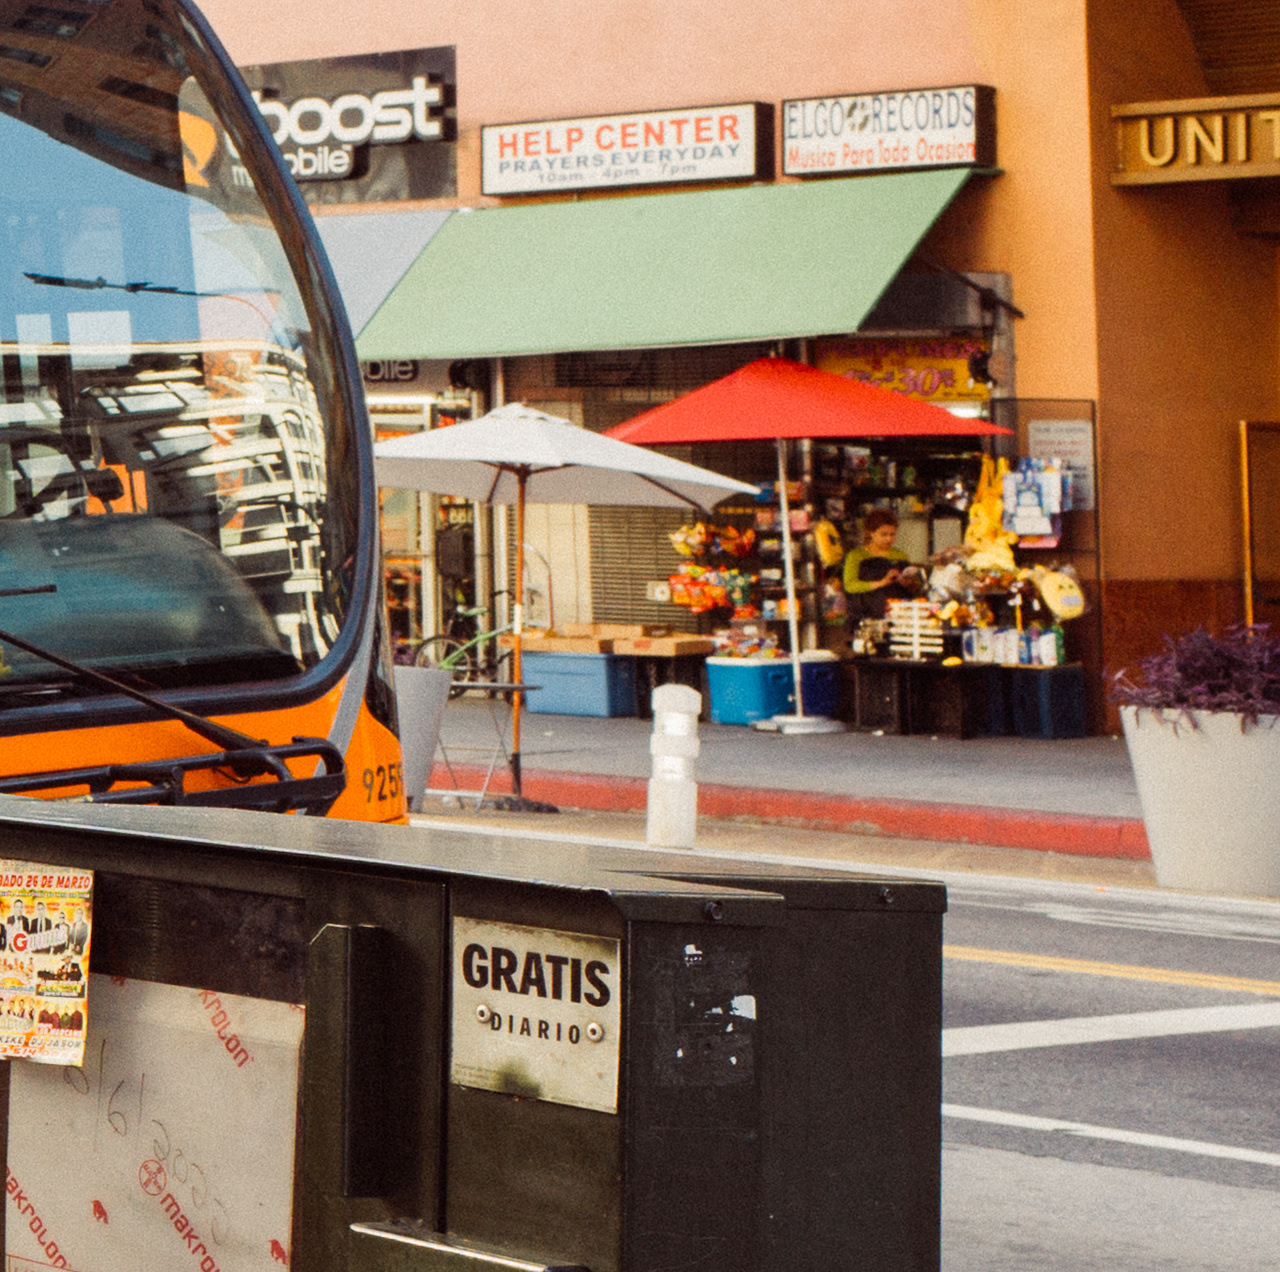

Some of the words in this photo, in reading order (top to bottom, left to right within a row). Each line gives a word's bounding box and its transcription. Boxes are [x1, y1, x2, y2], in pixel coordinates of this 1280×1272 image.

[871, 90, 974, 133] RECORDS
[498, 127, 584, 158] HELP
[595, 114, 740, 151] CENTER
[498, 152, 605, 174] PRAYERS
[611, 143, 740, 166] EVERYDAY
[26, 875, 39, 888] 26
[41, 876, 54, 888] DE
[56, 875, 91, 889] MARZO
[462, 943, 611, 1007] GRATIS
[491, 1012, 581, 1044] DIARIO
